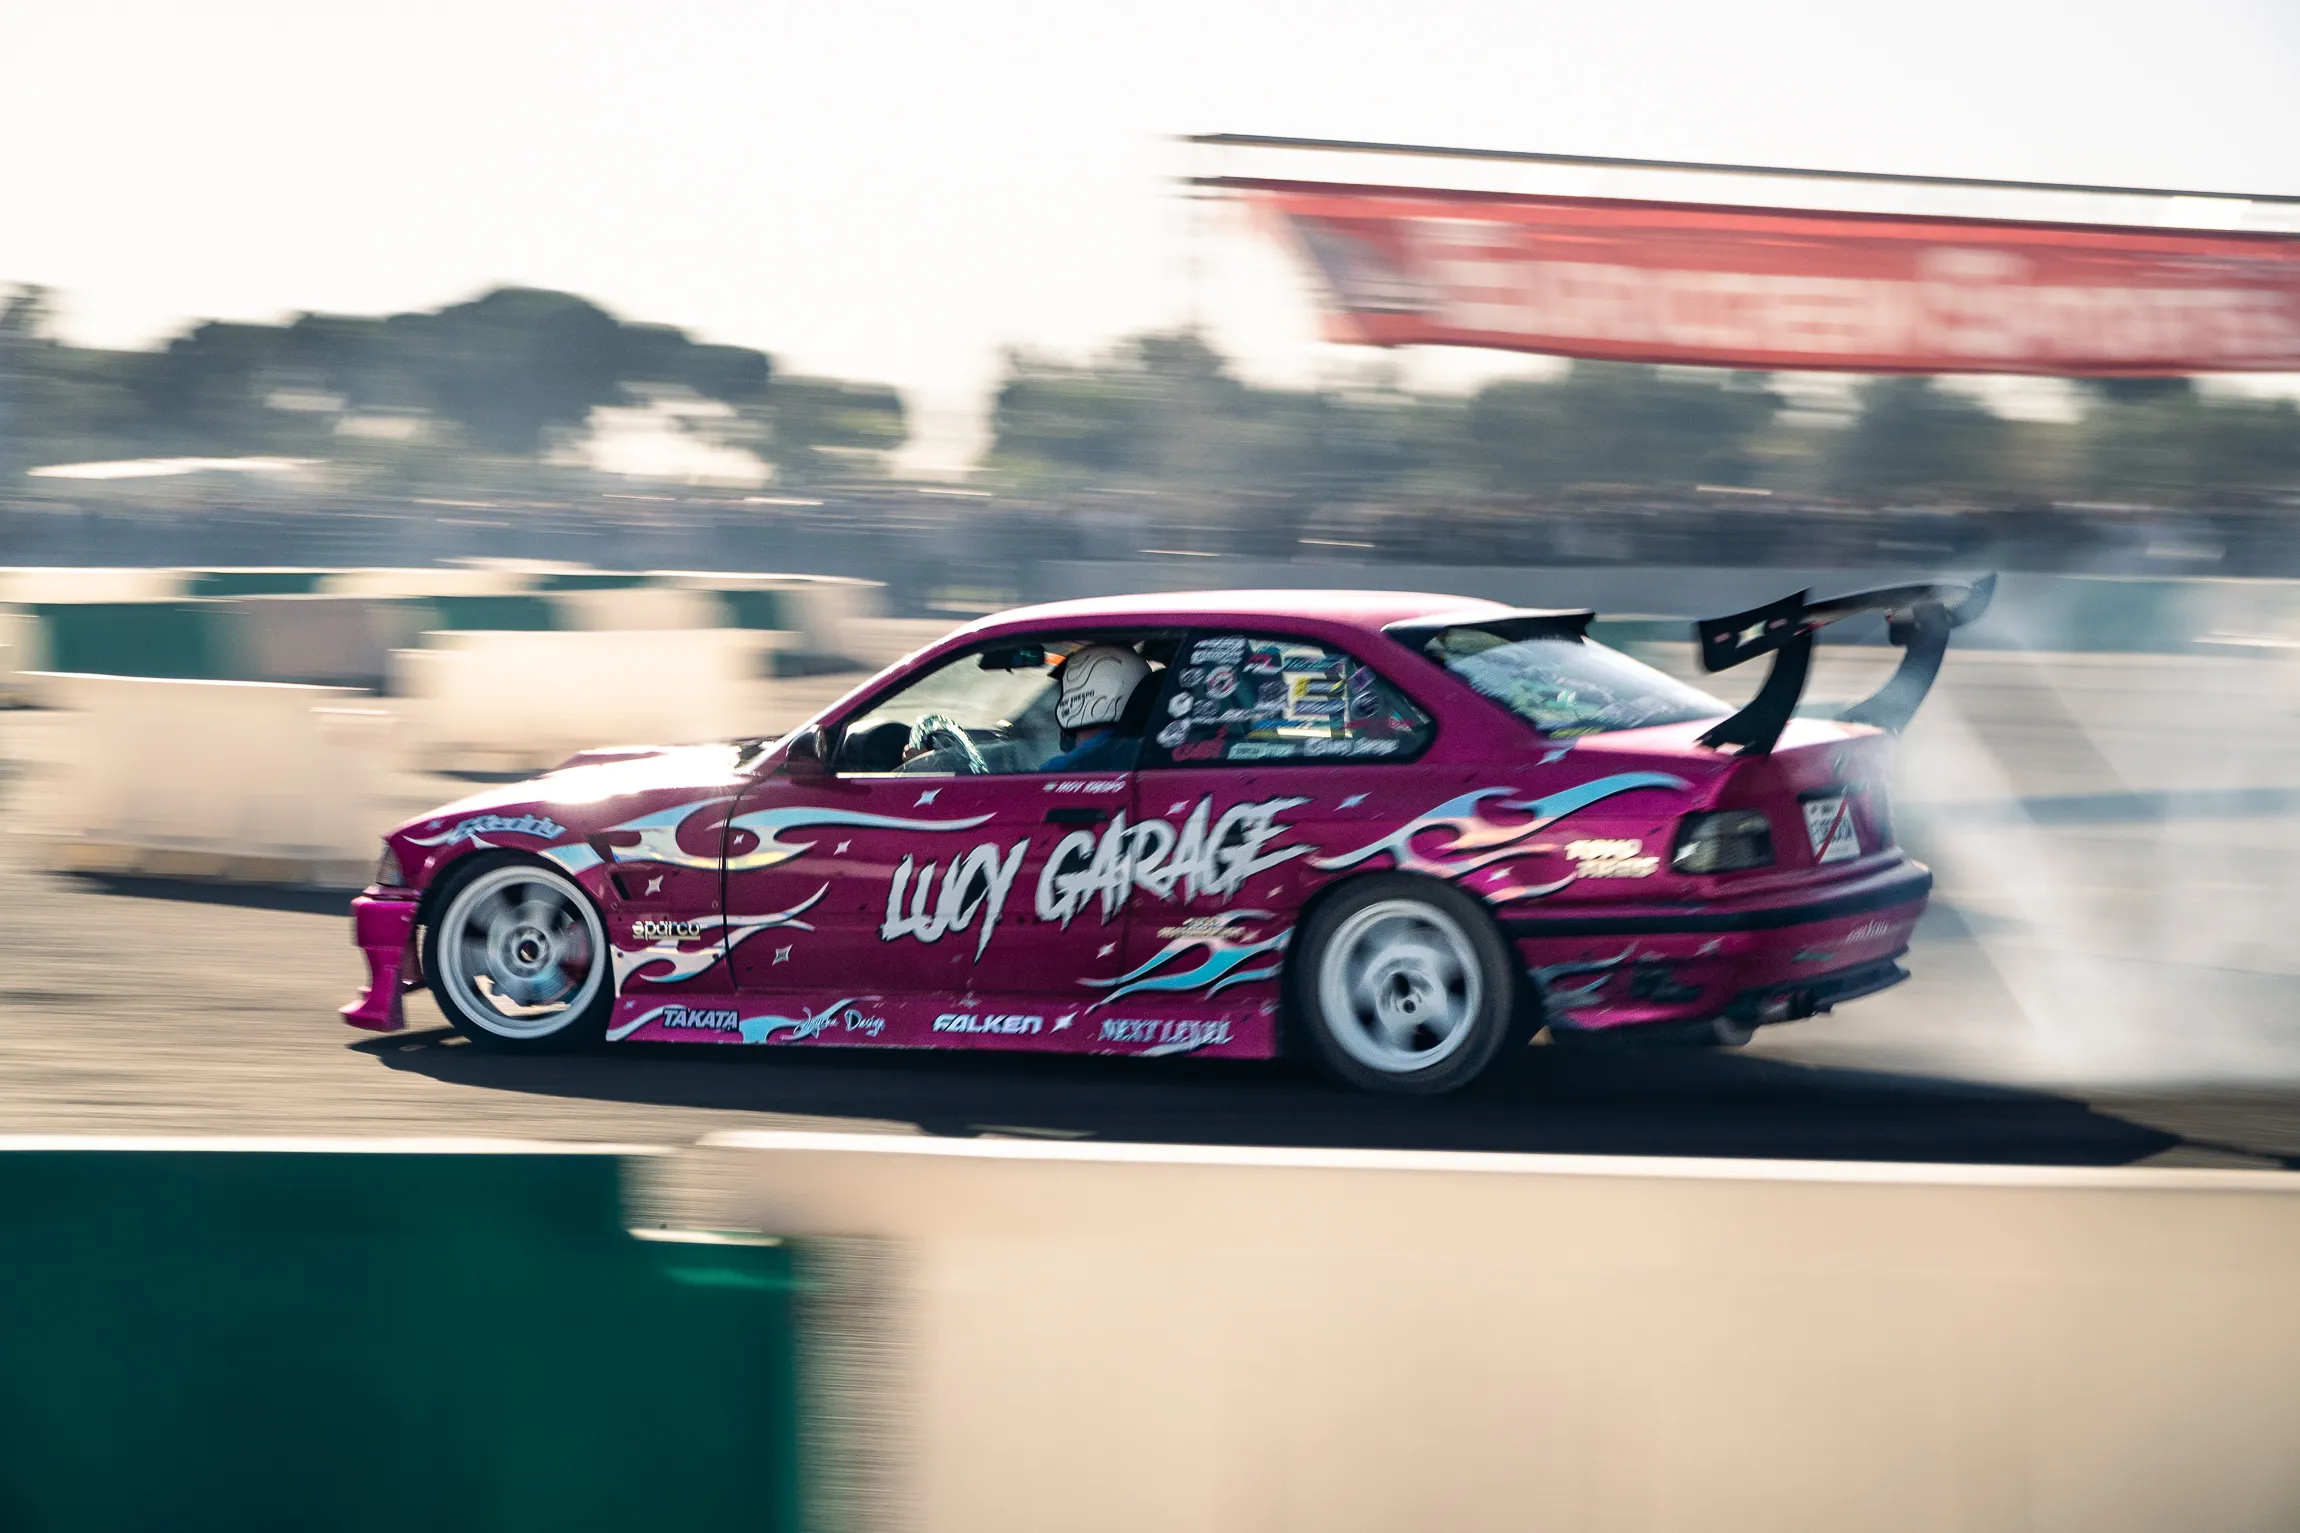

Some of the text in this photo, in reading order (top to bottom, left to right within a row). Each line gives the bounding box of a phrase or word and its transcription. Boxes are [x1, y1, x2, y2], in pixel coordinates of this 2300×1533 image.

[880, 794, 1318, 965] LUCY GARAGE
[631, 920, 701, 941] sparco
[663, 1008, 740, 1031] TAKATA
[844, 1009, 886, 1037] Design
[932, 1013, 1044, 1035] FALKEN
[1098, 1018, 1236, 1045] NEXT LEVEL
